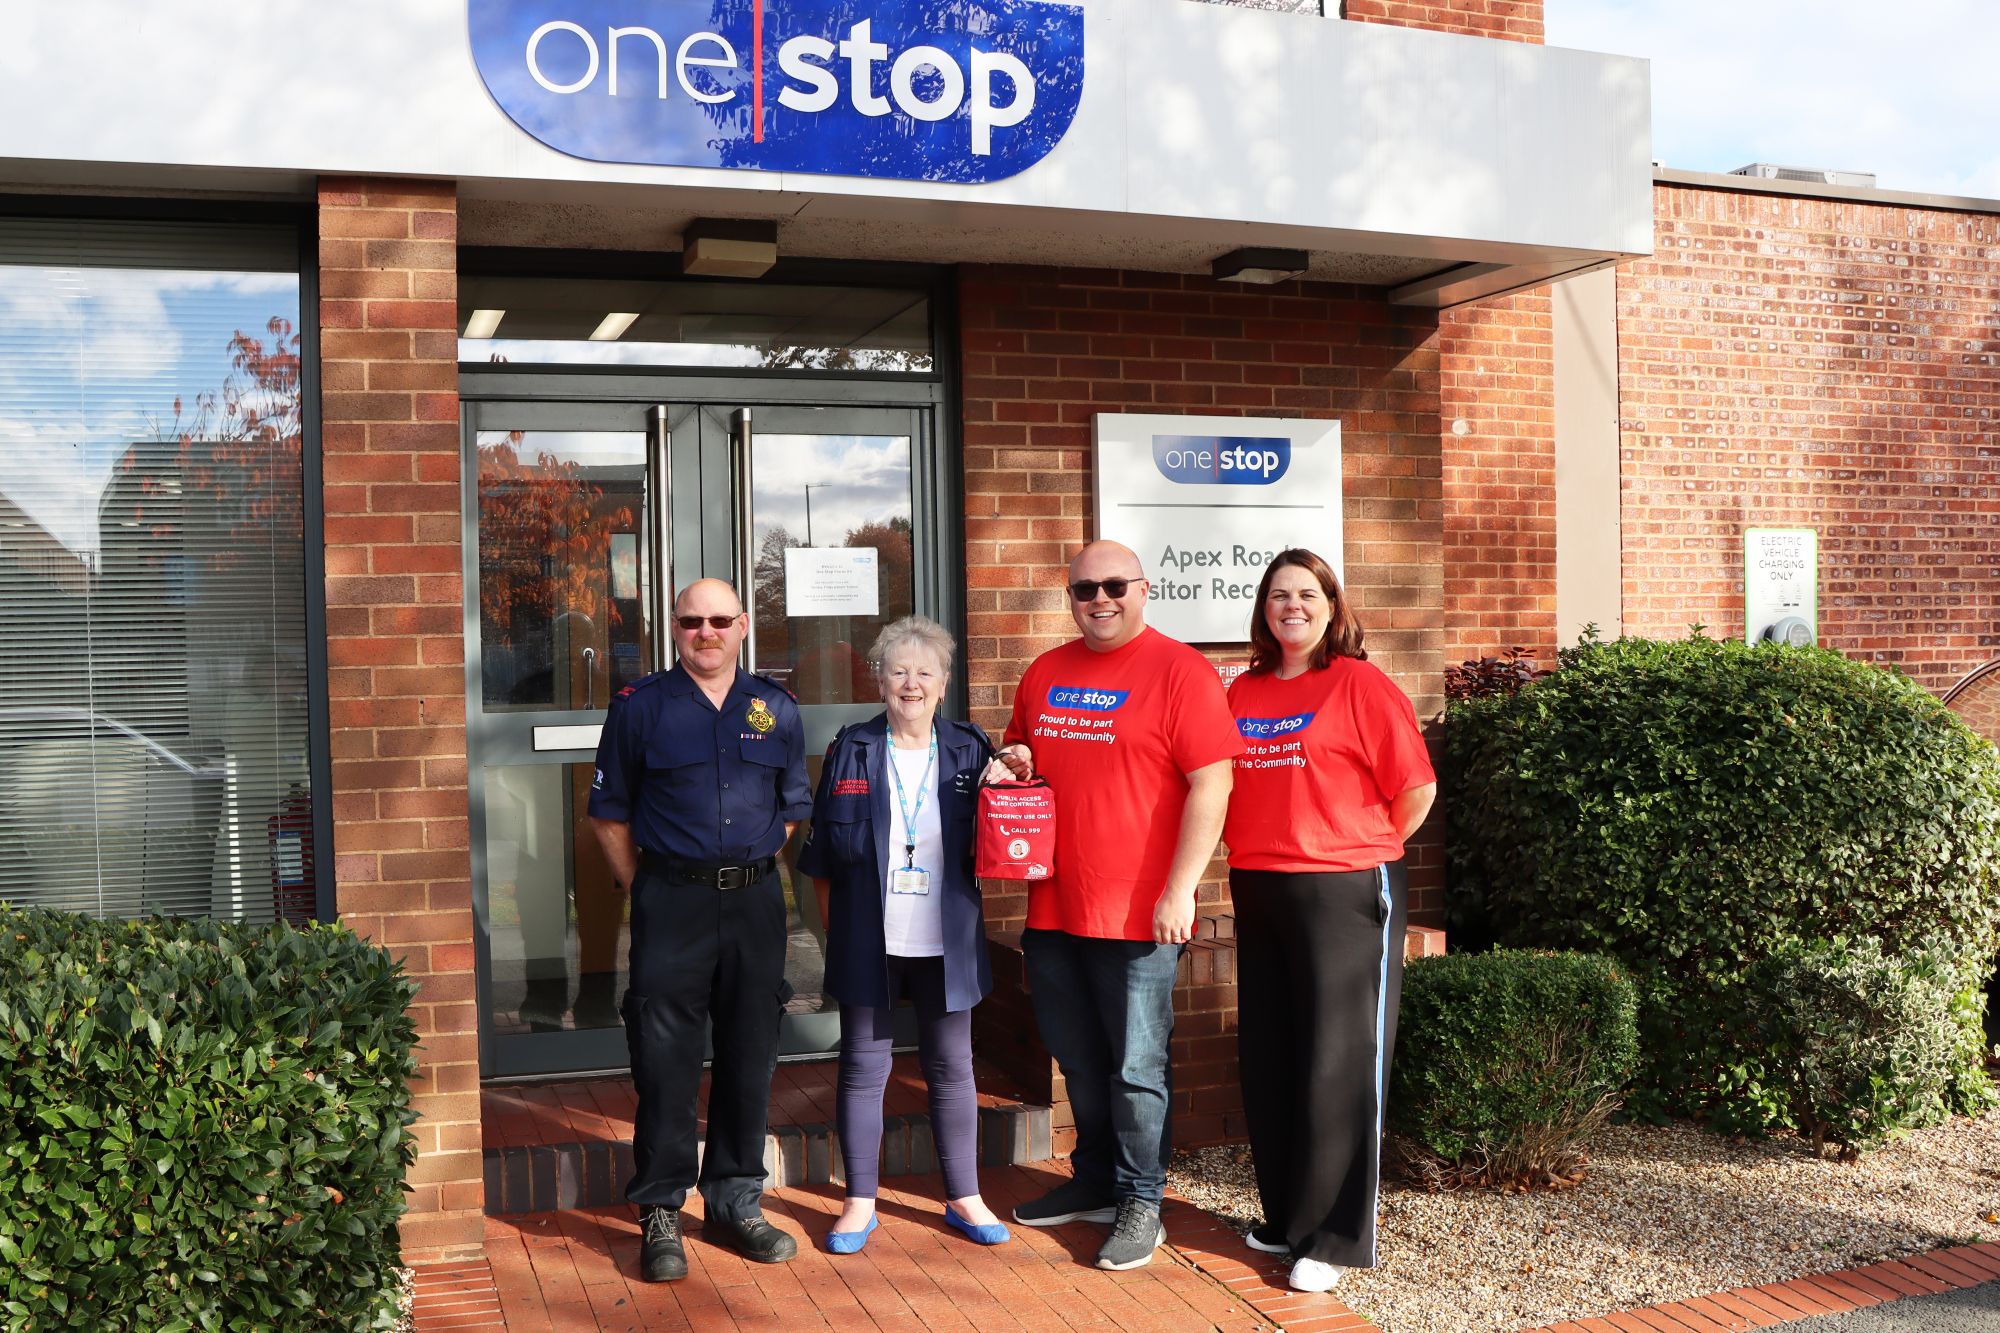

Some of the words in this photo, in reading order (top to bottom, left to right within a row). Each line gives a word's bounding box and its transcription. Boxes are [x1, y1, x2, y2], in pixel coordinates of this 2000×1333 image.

[526, 21, 737, 104] one
[777, 17, 1036, 155] stop
[1166, 449, 1211, 469] one
[1220, 445, 1279, 477] stop
[1761, 537, 1802, 546] ELECTRIC
[1160, 545, 1222, 573] Apex
[1232, 544, 1289, 567] Roa
[1764, 548, 1799, 557] VEHICLE
[1759, 560, 1805, 569] CHARGING
[1770, 572, 1793, 580] ONLY
[1055, 692, 1080, 703] one
[1082, 691, 1117, 709] stop
[1039, 714, 1067, 725] Proud
[1067, 717, 1078, 726] to
[1079, 717, 1091, 727] be
[1093, 719, 1113, 729] part
[1242, 722, 1270, 734] one
[1272, 717, 1303, 733] stop
[1034, 727, 1042, 736] of
[1043, 727, 1058, 737] the
[1060, 729, 1116, 745] Community
[1258, 746, 1267, 755] to
[1269, 744, 1280, 754] be
[1282, 741, 1301, 754] part
[1239, 758, 1253, 769] the
[1254, 755, 1307, 769] Community
[987, 812, 1022, 820] EMERGENCY
